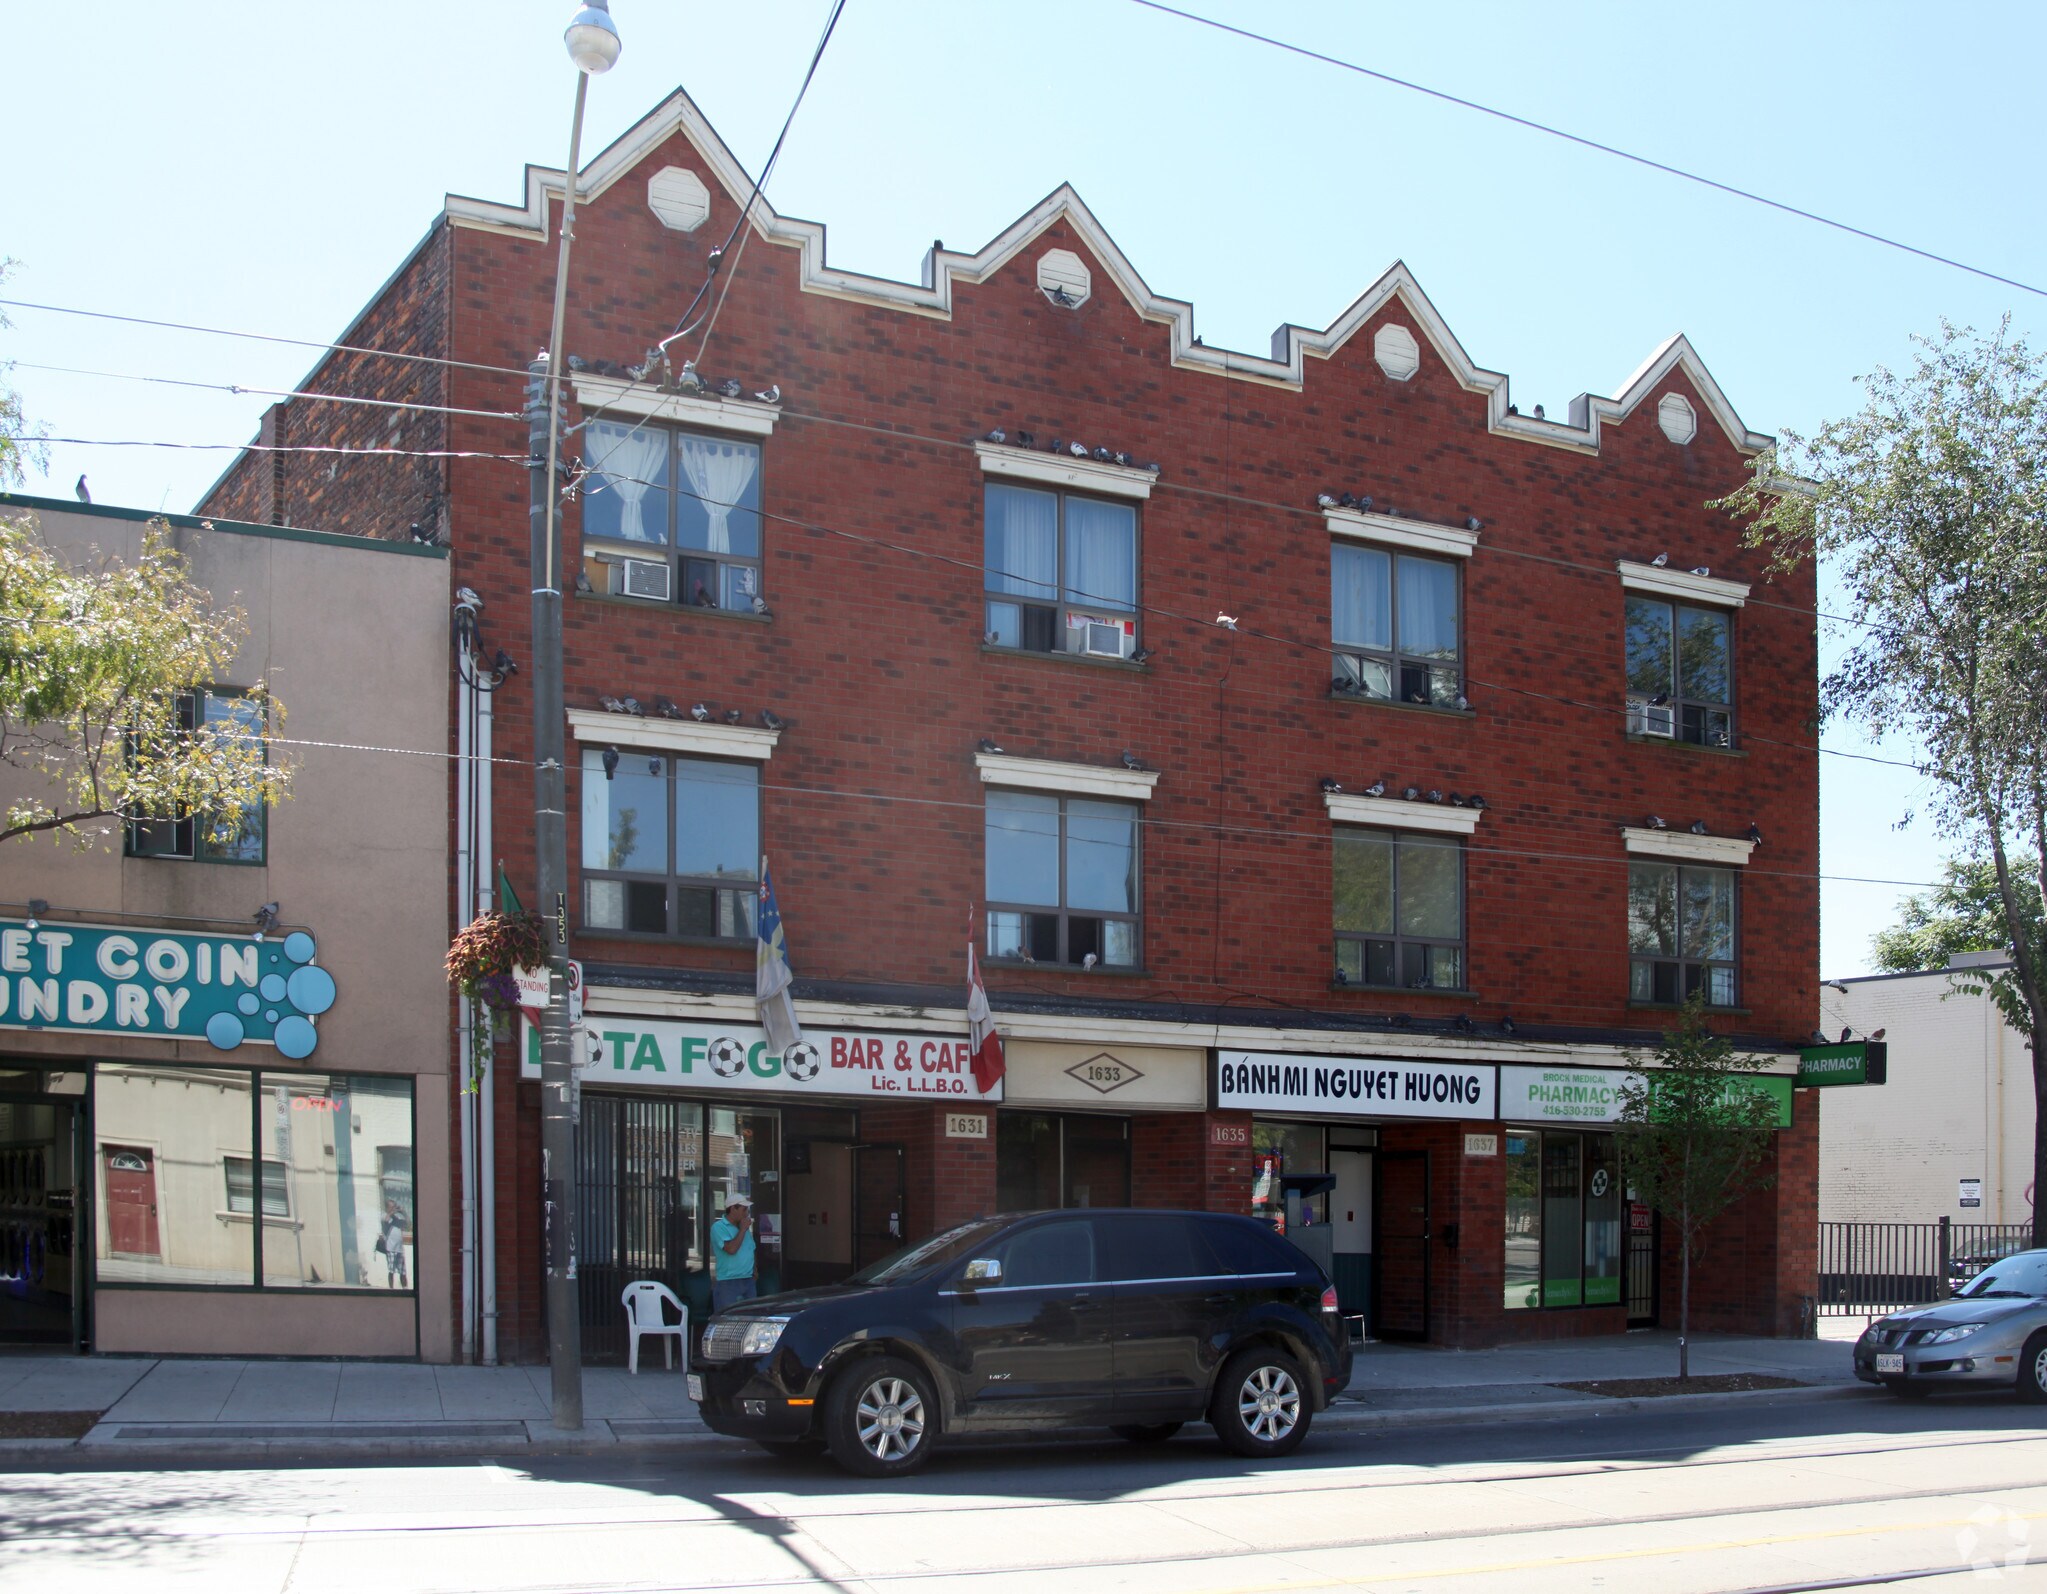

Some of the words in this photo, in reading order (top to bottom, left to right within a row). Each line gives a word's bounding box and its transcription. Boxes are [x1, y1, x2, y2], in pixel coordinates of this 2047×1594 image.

[96, 935, 258, 988] COIN
[831, 1036, 884, 1070] BAR
[894, 1040, 913, 1071] &
[1799, 1056, 1862, 1073] PHARMACY
[1088, 1066, 1121, 1081] 1633
[1543, 1073, 1570, 1083] BROCK
[1572, 1074, 1607, 1084] MEDICAL
[872, 1075, 901, 1091] Lic.
[908, 1077, 968, 1094] L.L.B.O.
[1315, 1067, 1399, 1100] NGUYET
[1405, 1072, 1481, 1105] HUONG
[1528, 1084, 1621, 1105] PHARMACY
[1543, 1105, 1606, 1117] 416-530-2755
[950, 1118, 983, 1134] 1631
[1216, 1127, 1246, 1142] 1635
[1468, 1138, 1494, 1151] 1637
[1632, 1214, 1649, 1226] OPEN
